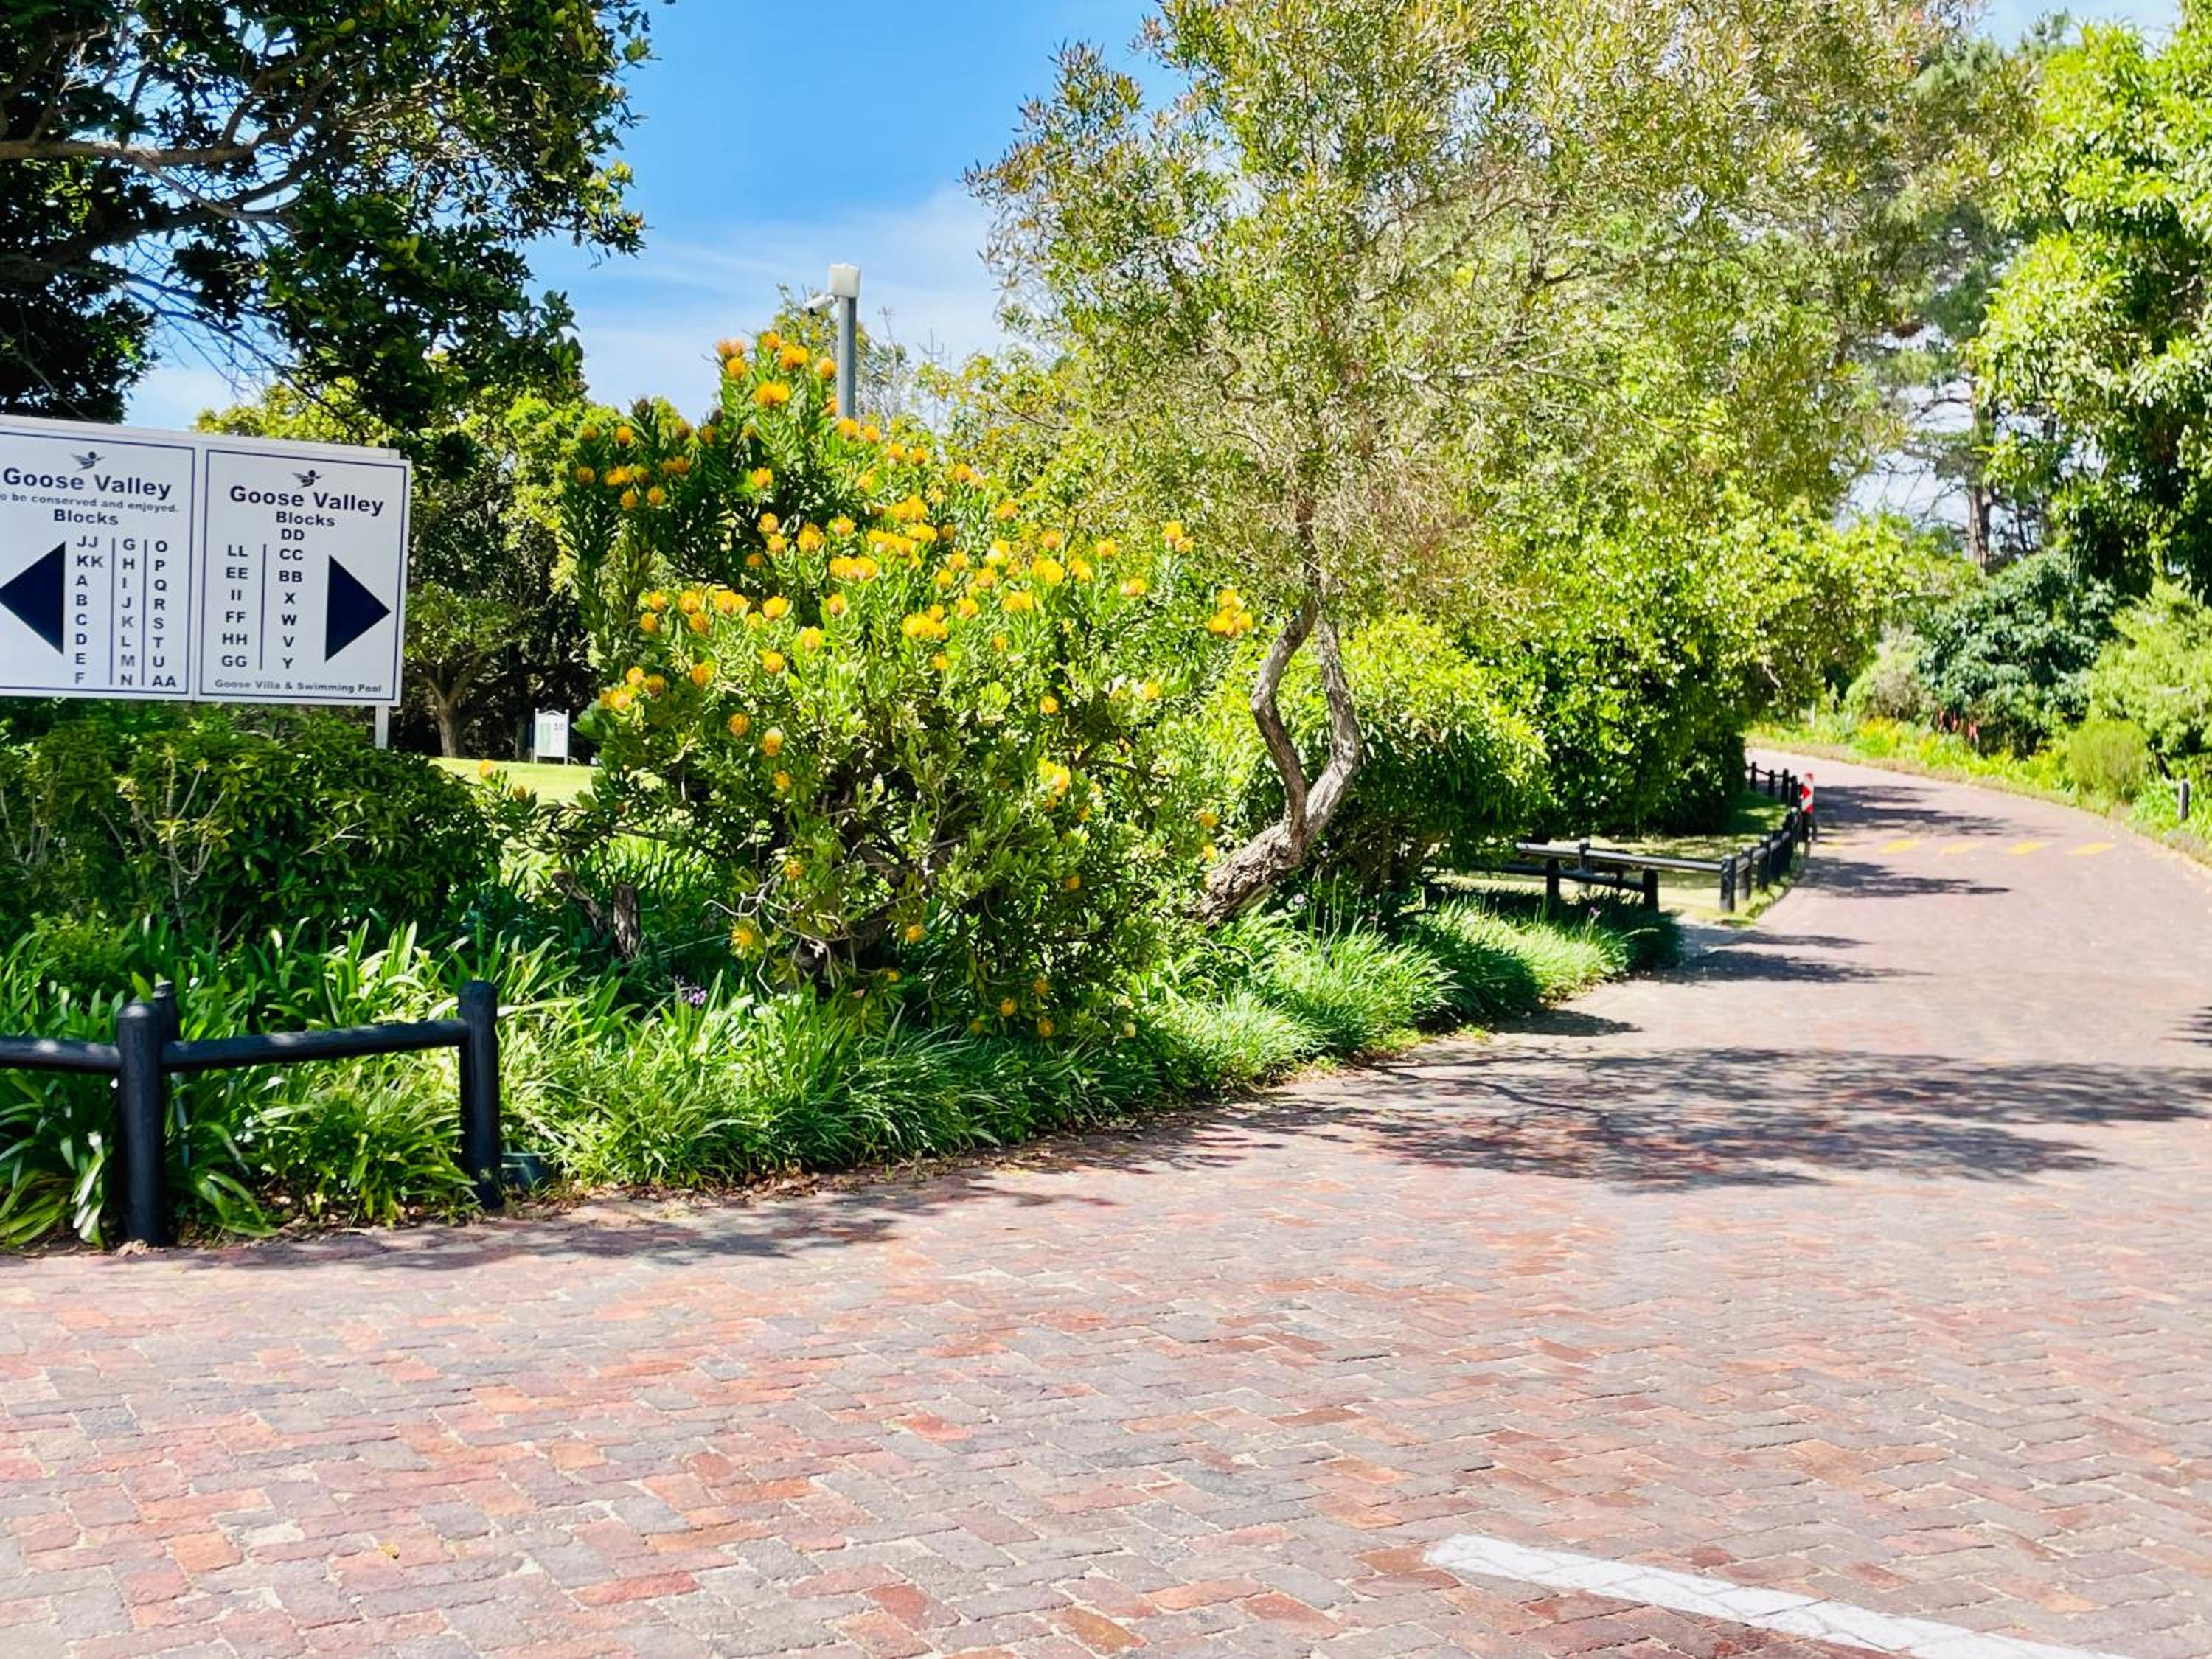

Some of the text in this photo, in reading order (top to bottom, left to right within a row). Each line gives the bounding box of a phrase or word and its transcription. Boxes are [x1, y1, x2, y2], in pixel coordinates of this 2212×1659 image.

[4, 467, 171, 500] Goose Valley
[12, 493, 27, 501] be
[32, 496, 97, 507] conserved
[102, 501, 123, 509] and
[230, 485, 383, 516] Goose Valley
[55, 509, 118, 525] Blocks
[276, 511, 335, 526] Blocks
[282, 529, 304, 540] DD
[77, 535, 97, 548] JJ
[123, 538, 135, 550] G
[156, 540, 167, 552] O
[228, 545, 248, 557] LL
[279, 549, 303, 560] CC
[77, 555, 102, 567] KK
[123, 558, 134, 569] H
[155, 560, 165, 571] P
[226, 567, 248, 579] EE
[279, 571, 302, 582] BB
[76, 575, 88, 586] A
[122, 577, 126, 588] I
[155, 580, 167, 591] Q
[76, 594, 87, 606] B
[232, 590, 241, 600] II
[285, 593, 295, 604] X
[122, 597, 131, 608] J
[154, 599, 165, 611] R
[76, 613, 87, 625] C
[122, 616, 133, 627] K
[153, 617, 164, 629] S
[226, 611, 246, 623] FF
[282, 615, 296, 625] W
[76, 633, 87, 644] D
[122, 636, 131, 647] L
[153, 637, 164, 648] T
[223, 633, 247, 645] HH
[283, 636, 294, 647] V
[76, 653, 86, 664] E
[121, 655, 135, 667] M
[153, 656, 164, 667] U
[222, 655, 246, 667] GG
[283, 658, 293, 669] Y
[75, 672, 85, 684] F
[121, 675, 132, 686] N
[152, 675, 176, 687] AA
[215, 679, 251, 688] Goose
[297, 682, 354, 693] Swimming
[358, 684, 381, 692] Pool
